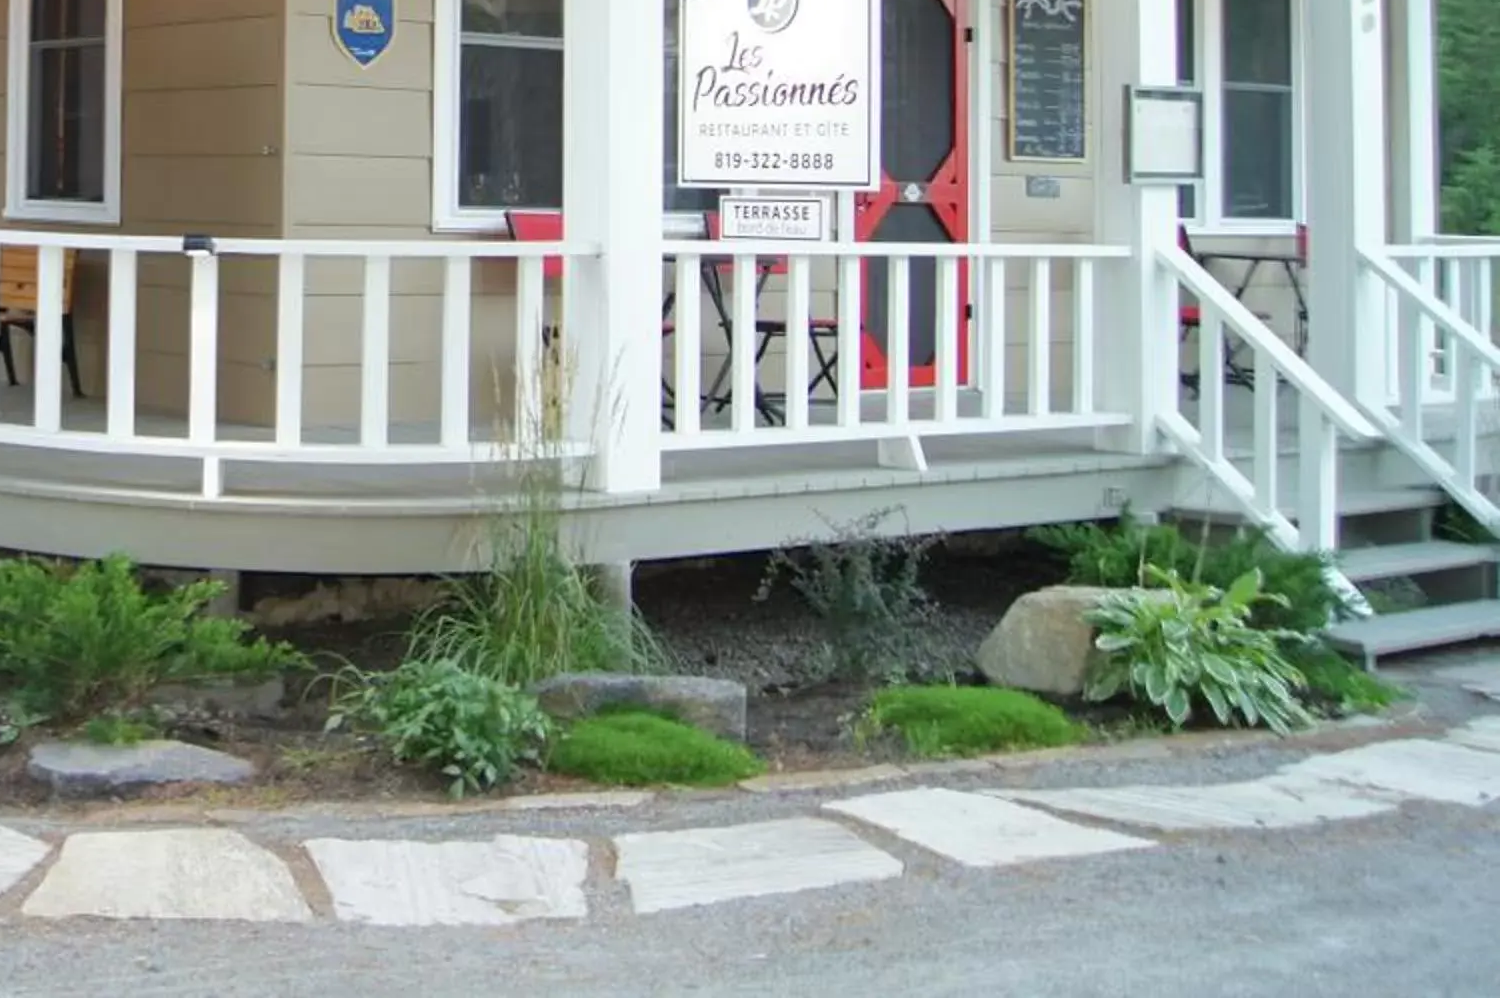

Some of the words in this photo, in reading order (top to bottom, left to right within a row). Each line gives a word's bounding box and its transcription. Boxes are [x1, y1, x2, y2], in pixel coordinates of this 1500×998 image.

[721, 31, 763, 73] Les
[693, 66, 859, 112] Passionnés
[698, 123, 788, 137] RESTAURANT
[795, 123, 812, 137] ET
[714, 152, 834, 170] 819-322-8888
[734, 205, 810, 221] TERRASSE
